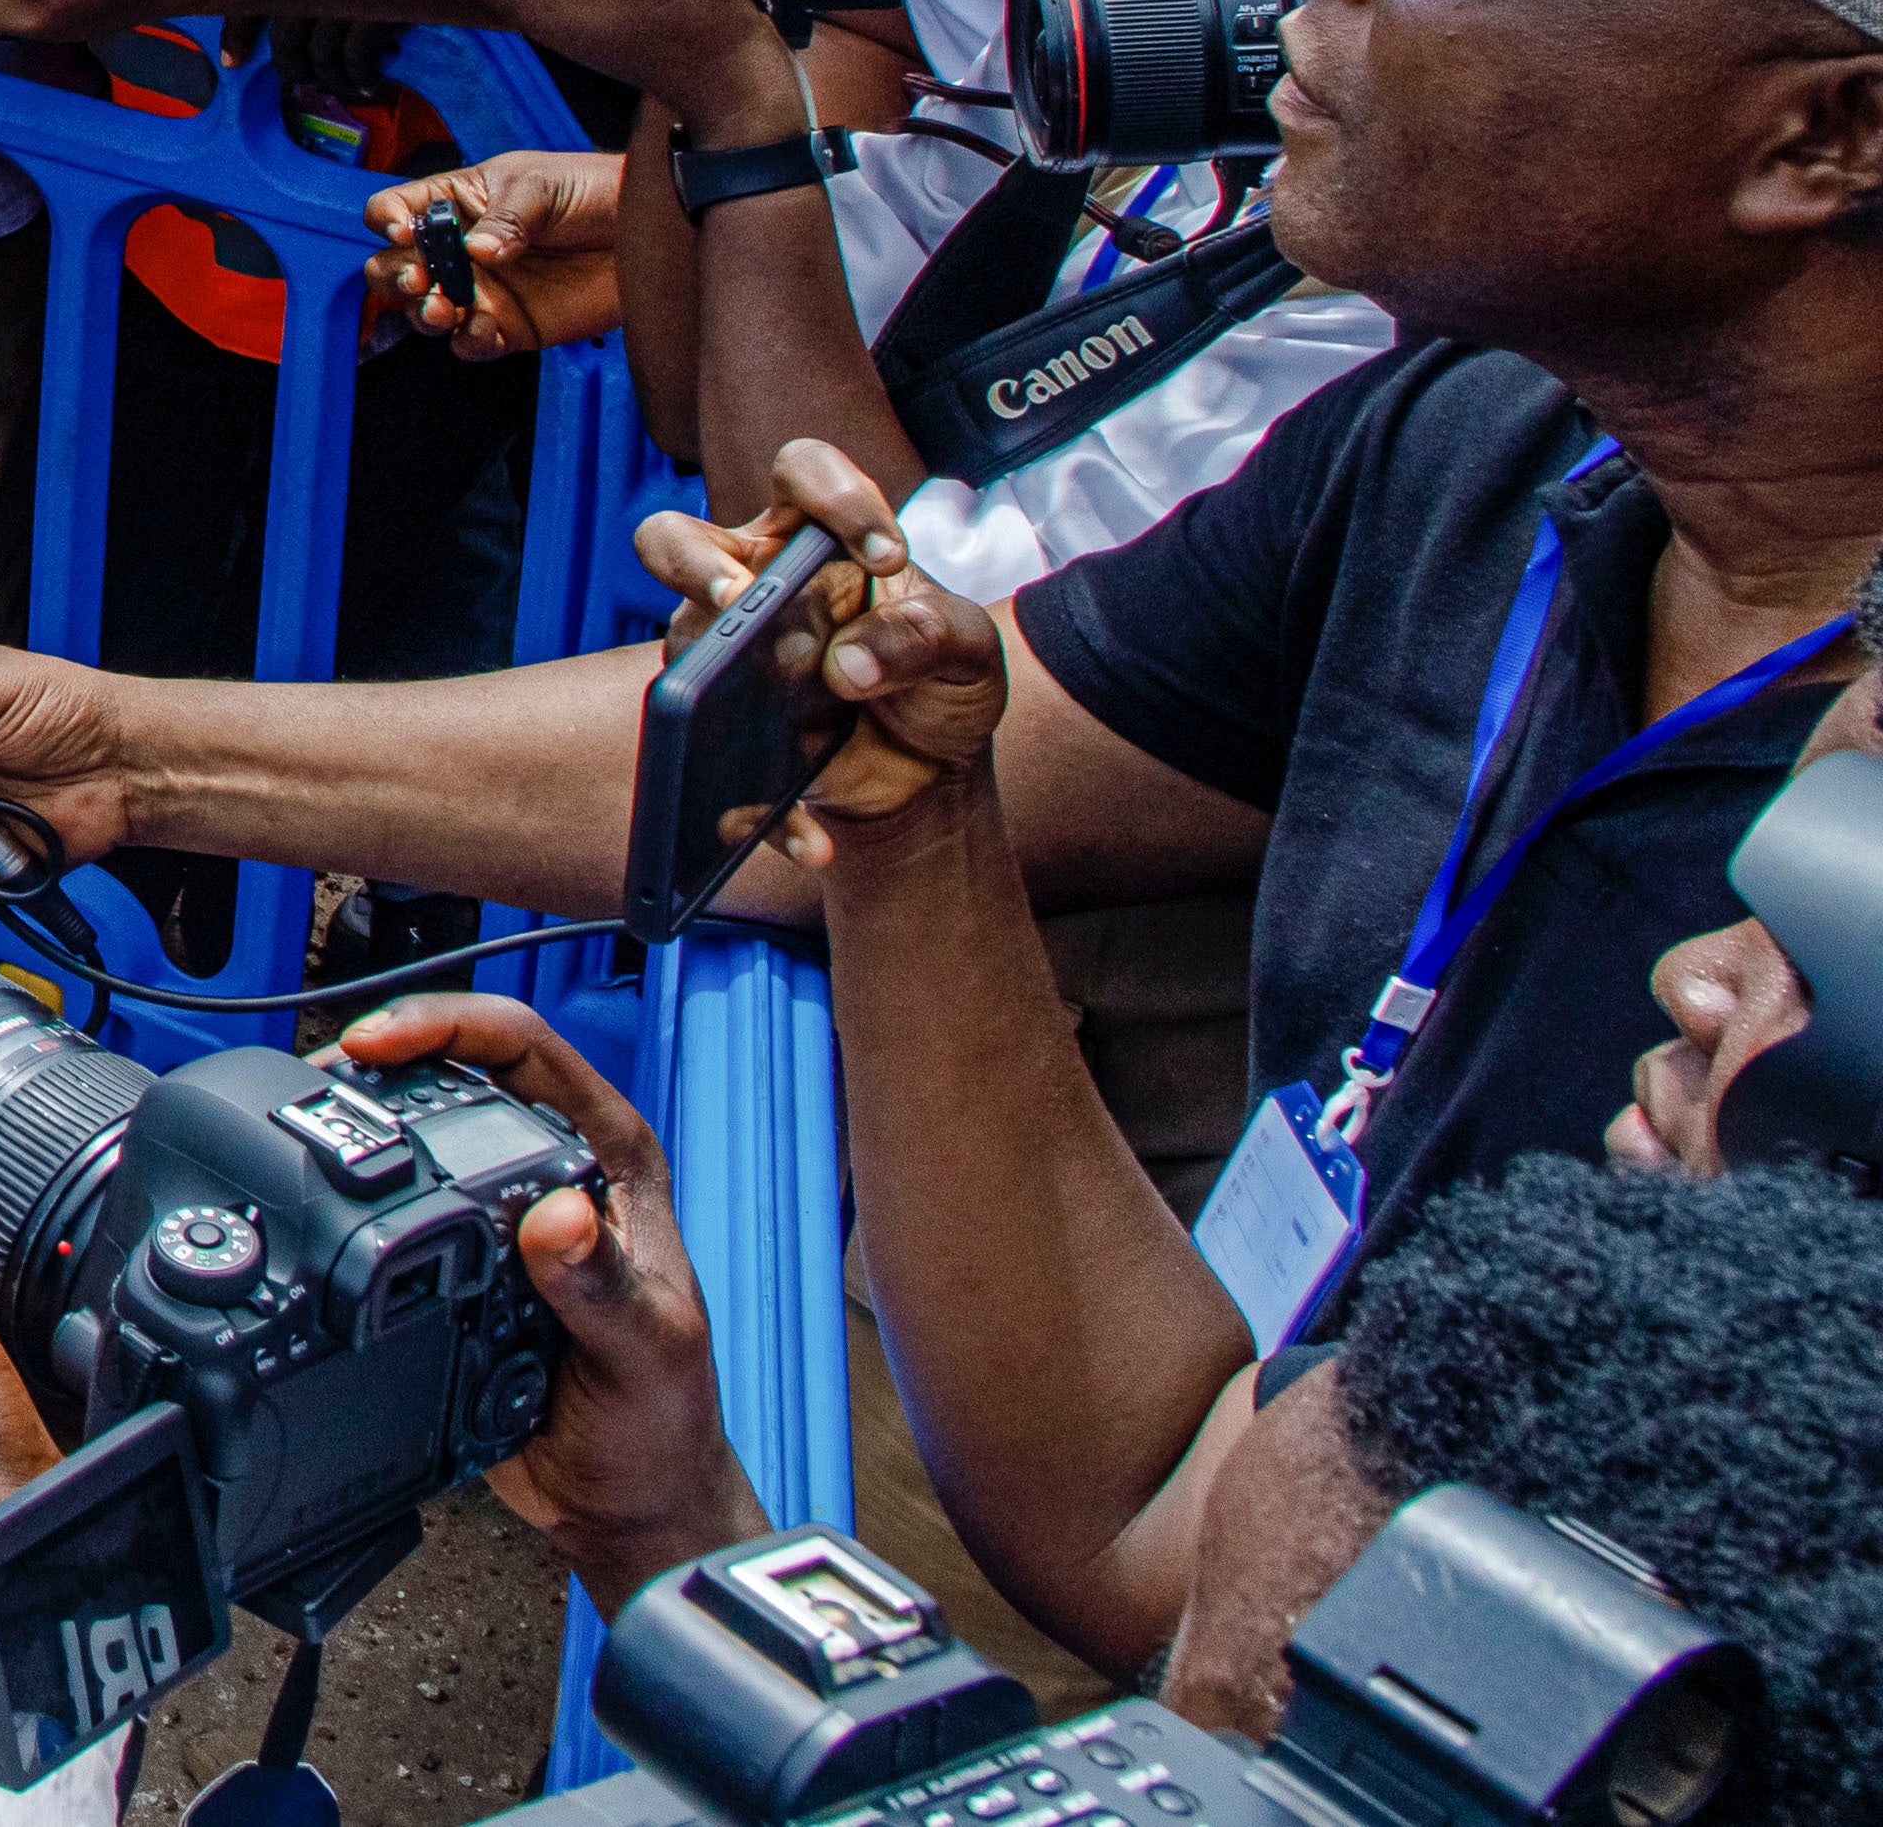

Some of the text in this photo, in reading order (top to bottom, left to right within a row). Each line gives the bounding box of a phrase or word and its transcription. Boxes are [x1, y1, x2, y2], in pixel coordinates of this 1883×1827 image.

[987, 314, 1156, 420] Canon
[161, 1233, 184, 1245] SCN
[288, 1284, 307, 1301] ON
[215, 1328, 236, 1347] OFF
